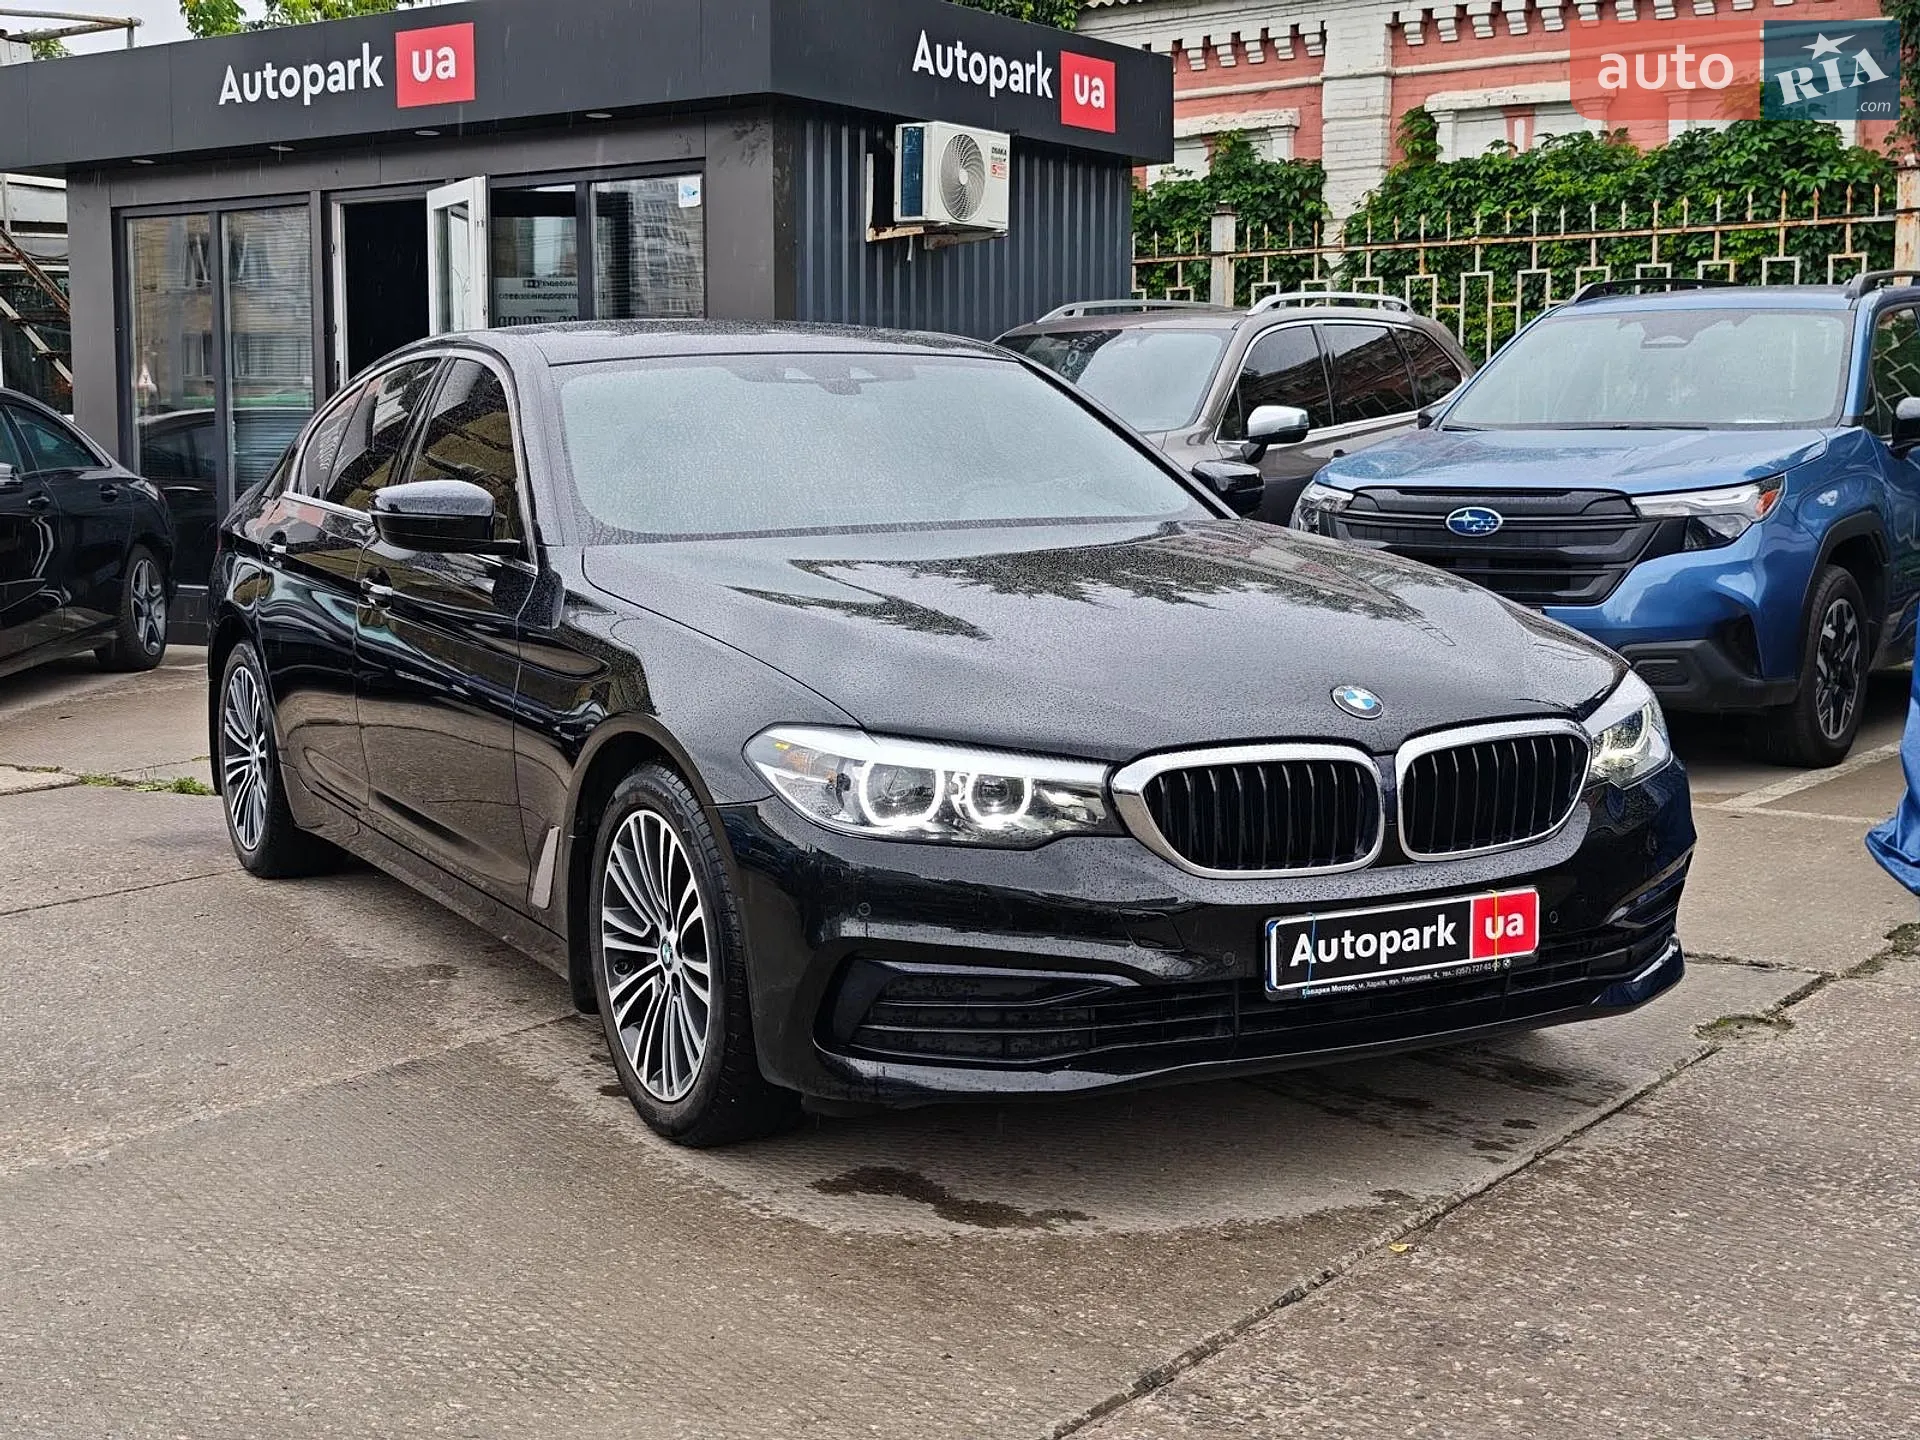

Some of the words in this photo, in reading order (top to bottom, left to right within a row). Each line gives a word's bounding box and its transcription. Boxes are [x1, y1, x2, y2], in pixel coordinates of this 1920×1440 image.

[218, 42, 384, 105] Autopark
[412, 46, 457, 83] ua
[912, 29, 1053, 99] Autopark
[1073, 73, 1106, 109] ua
[1289, 914, 1457, 967] Autopark
[1485, 912, 1525, 940] ua
